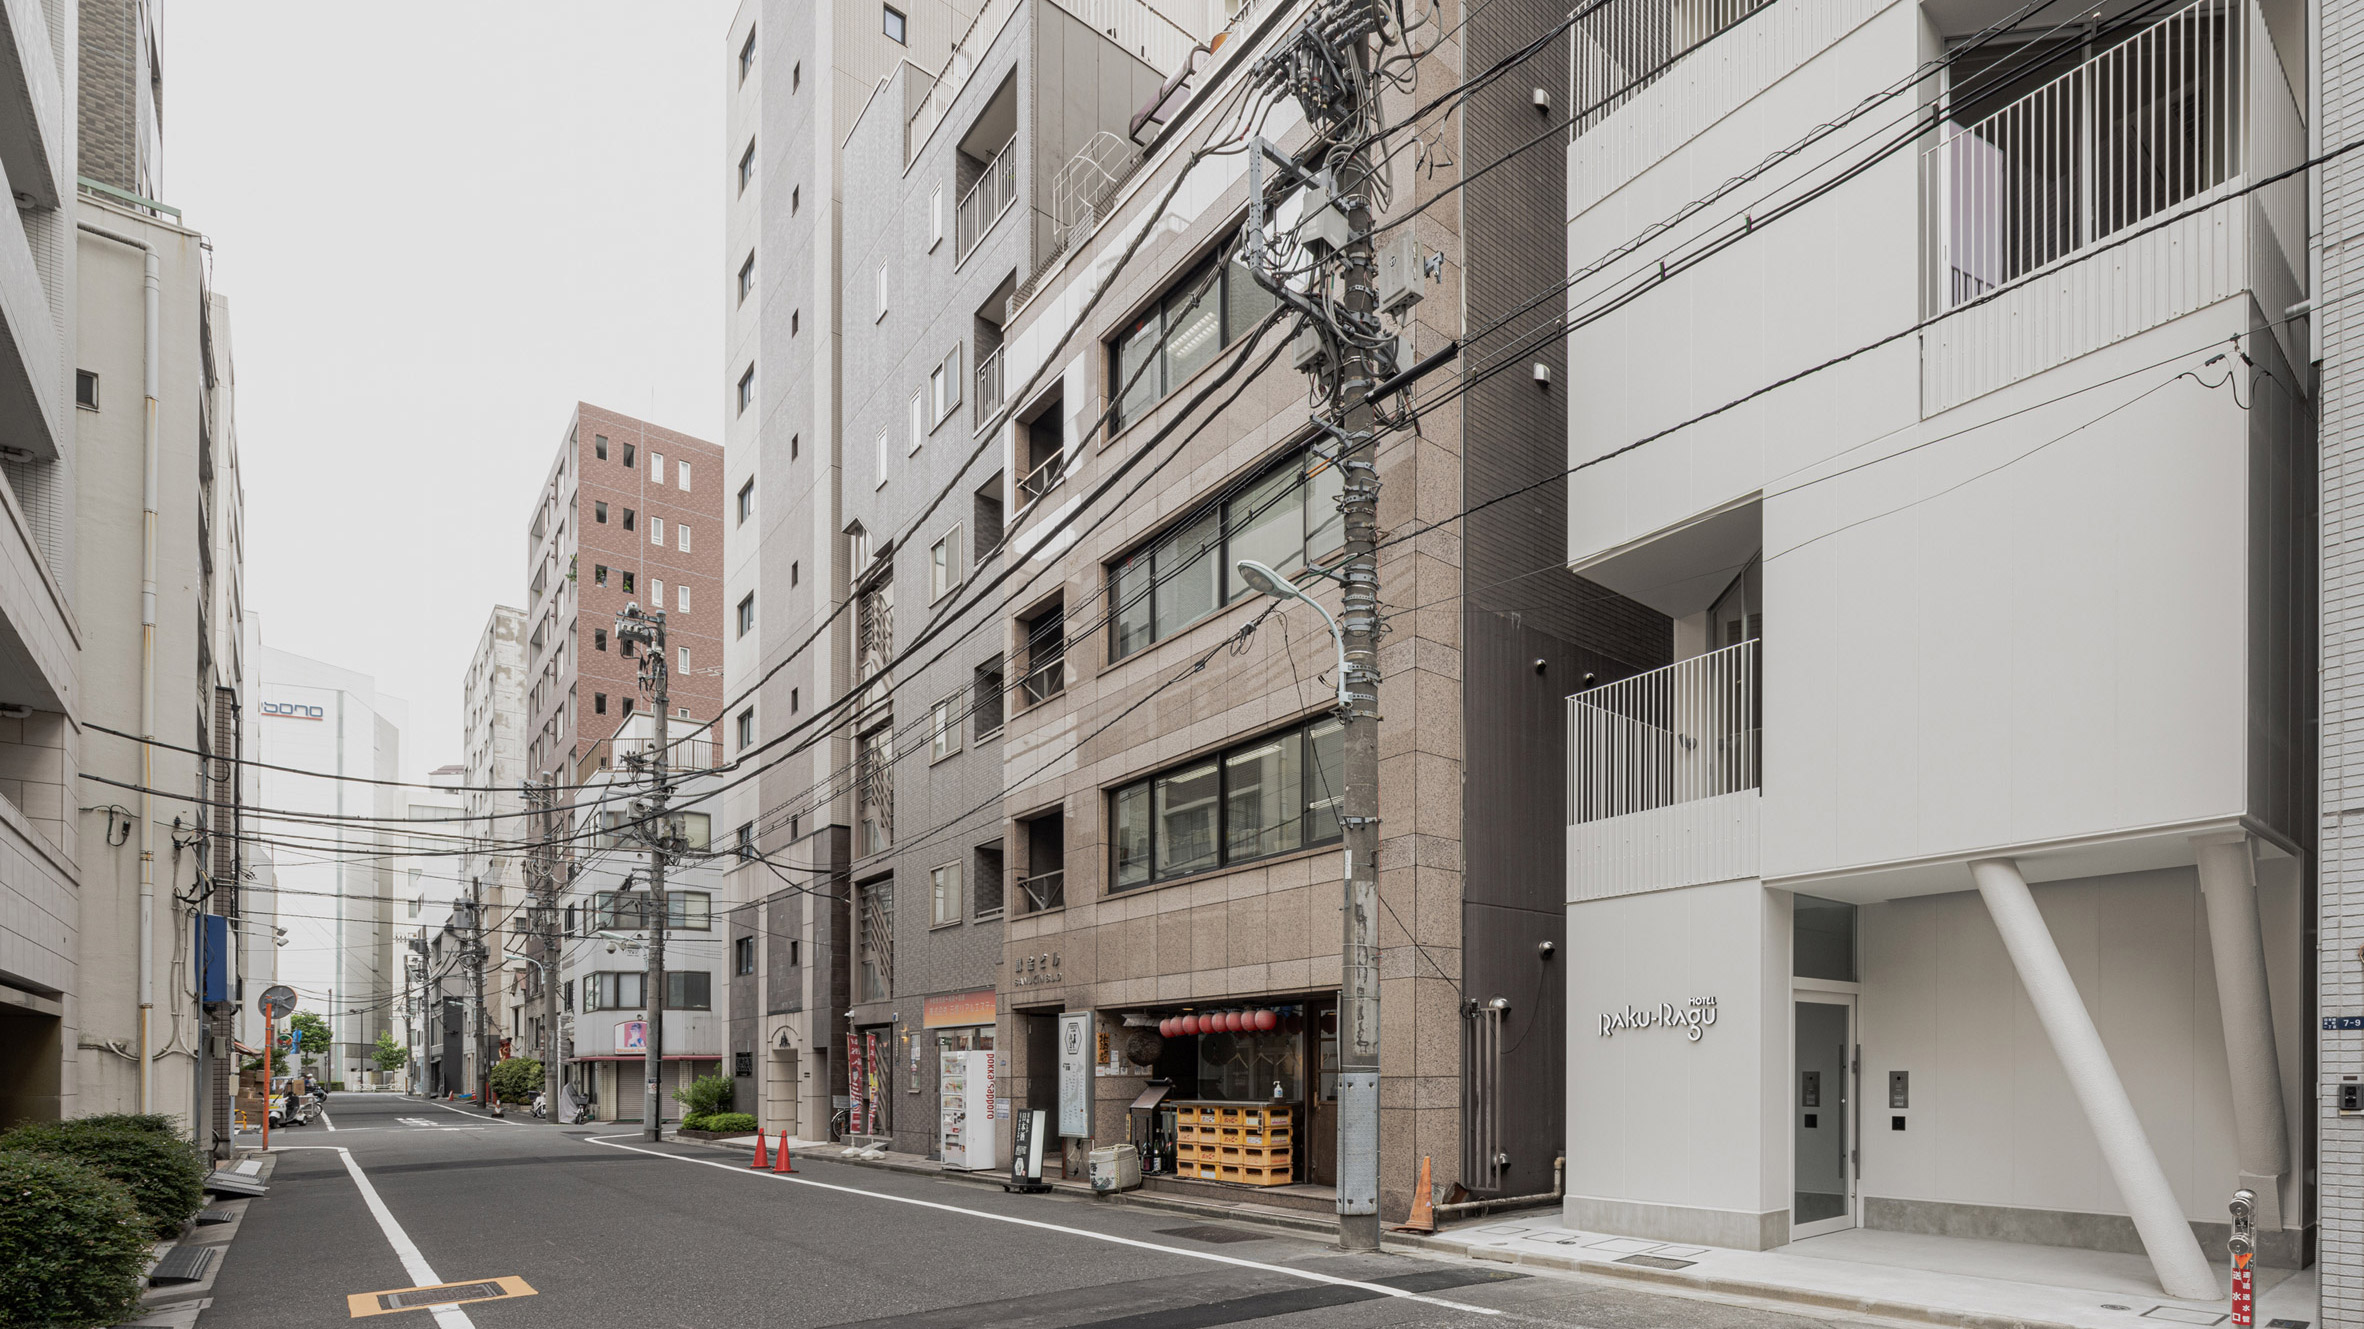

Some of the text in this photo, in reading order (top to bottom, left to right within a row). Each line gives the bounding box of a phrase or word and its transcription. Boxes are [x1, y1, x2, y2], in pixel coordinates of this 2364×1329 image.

[1688, 996, 1717, 1006] HOTEL
[2343, 1019, 2361, 1027] 7-9
[985, 1053, 995, 1120] pokka sapporo
[2232, 1271, 2242, 1322] 送水口
